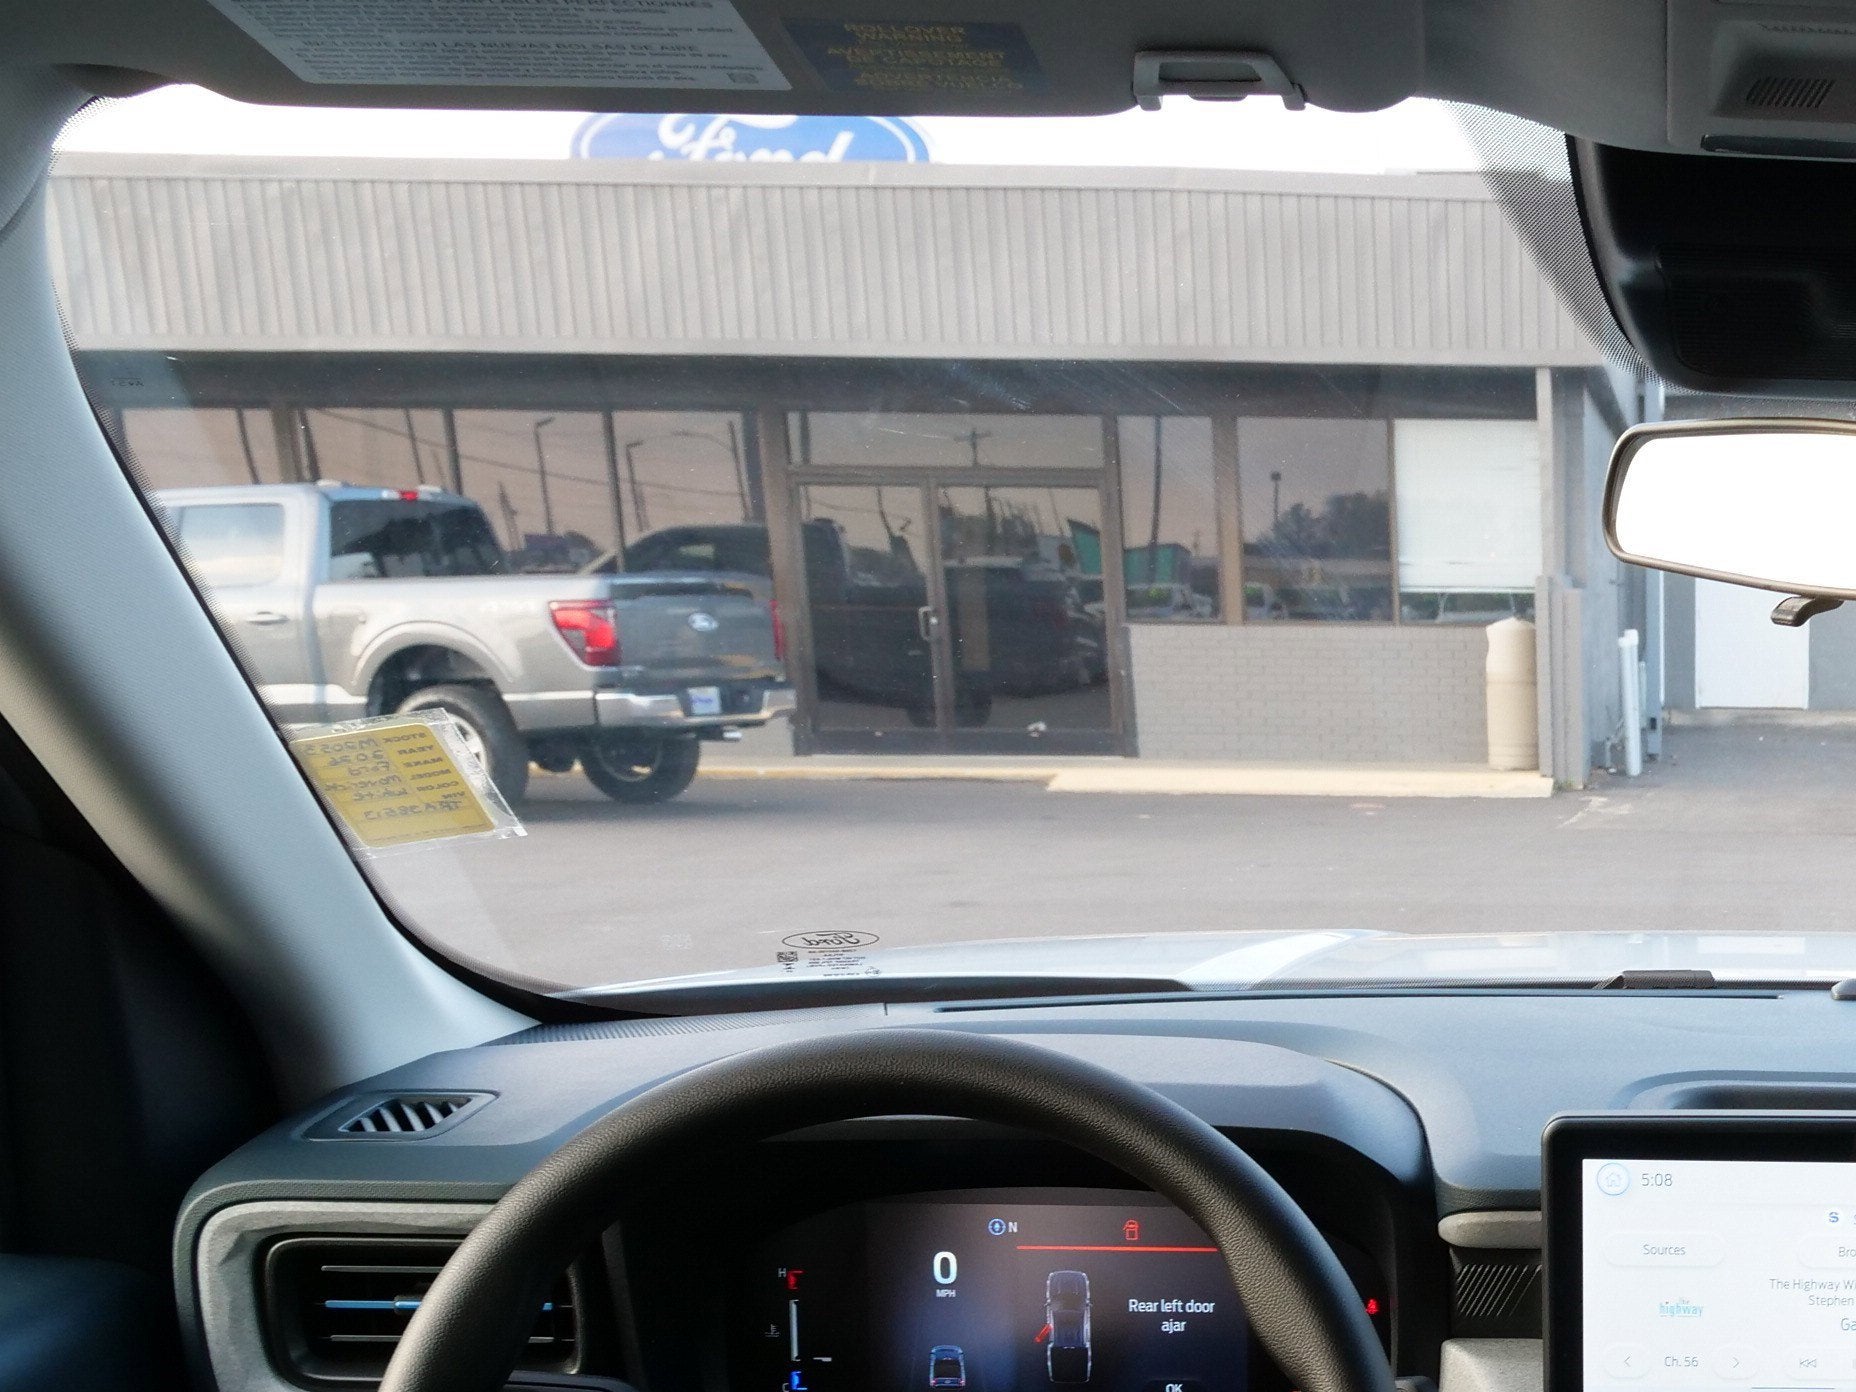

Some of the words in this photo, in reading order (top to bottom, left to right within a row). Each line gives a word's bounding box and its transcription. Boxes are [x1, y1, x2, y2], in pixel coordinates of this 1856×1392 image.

[1641, 1173, 1673, 1187] 5:08
[1008, 1222, 1018, 1233] N
[1642, 1243, 1686, 1257] Sources
[932, 1251, 958, 1285] 0
[1769, 1279, 1790, 1290] The
[1792, 1279, 1841, 1292] Highway
[936, 1289, 956, 1298] MPH
[1128, 1299, 1159, 1313] Rear
[1161, 1299, 1183, 1313] left
[1186, 1300, 1215, 1313] door
[1808, 1295, 1854, 1308] Stephen
[1161, 1319, 1187, 1334] ajar
[1664, 1356, 1681, 1367] Ch.
[1684, 1357, 1699, 1367] 56
